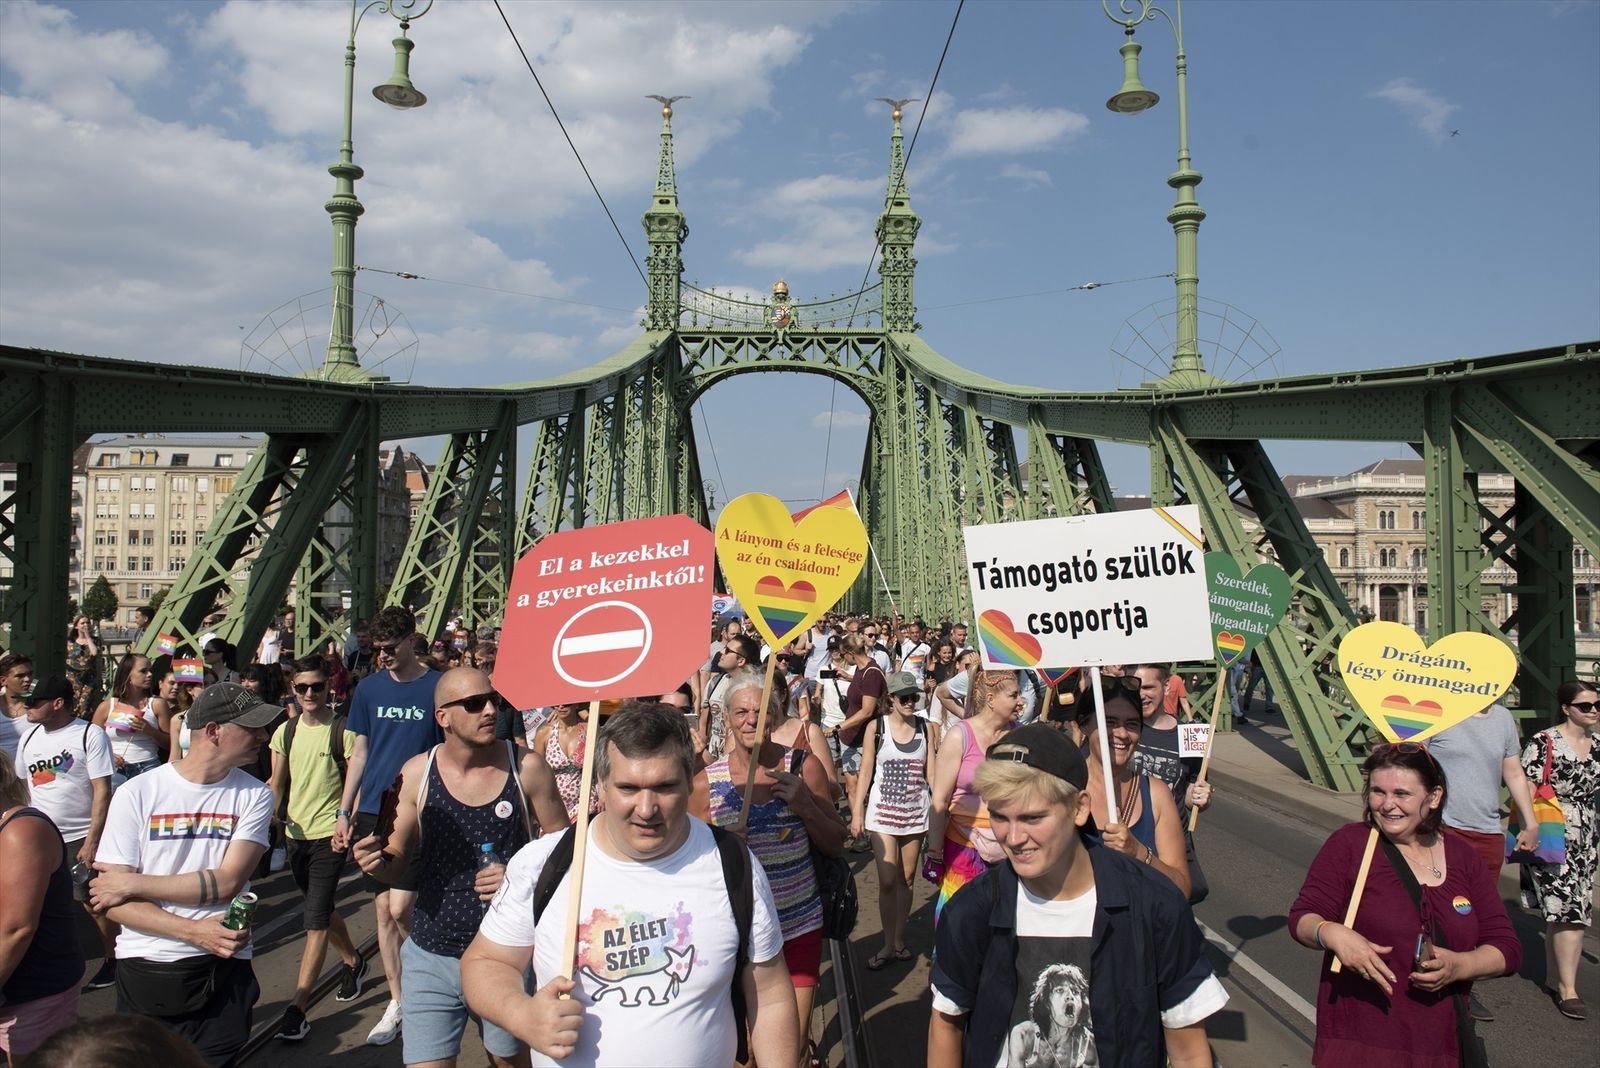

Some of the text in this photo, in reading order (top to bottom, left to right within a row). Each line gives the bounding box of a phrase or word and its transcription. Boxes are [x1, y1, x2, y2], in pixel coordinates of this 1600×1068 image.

[537, 539, 690, 577] El a kezekkel
[719, 527, 863, 564] A lányom és a felesége
[736, 552, 841, 577] az én családom!
[972, 542, 1196, 592] Támogató szülők
[516, 565, 705, 609] a gyerekeinktől!
[1215, 571, 1272, 598] Szeretlek,
[1208, 591, 1275, 619] ámogatlak,
[1027, 600, 1148, 640] csoportja
[1210, 611, 1269, 636] lfogadlak!
[181, 664, 197, 676] 25
[1381, 645, 1472, 673] Drágám,
[1345, 661, 1500, 697] légy önmagad!
[28, 749, 73, 778] PRIDE
[158, 817, 233, 837] LEVI'S
[604, 917, 667, 948] AZ ÉLET
[605, 945, 650, 972] SZÉP
